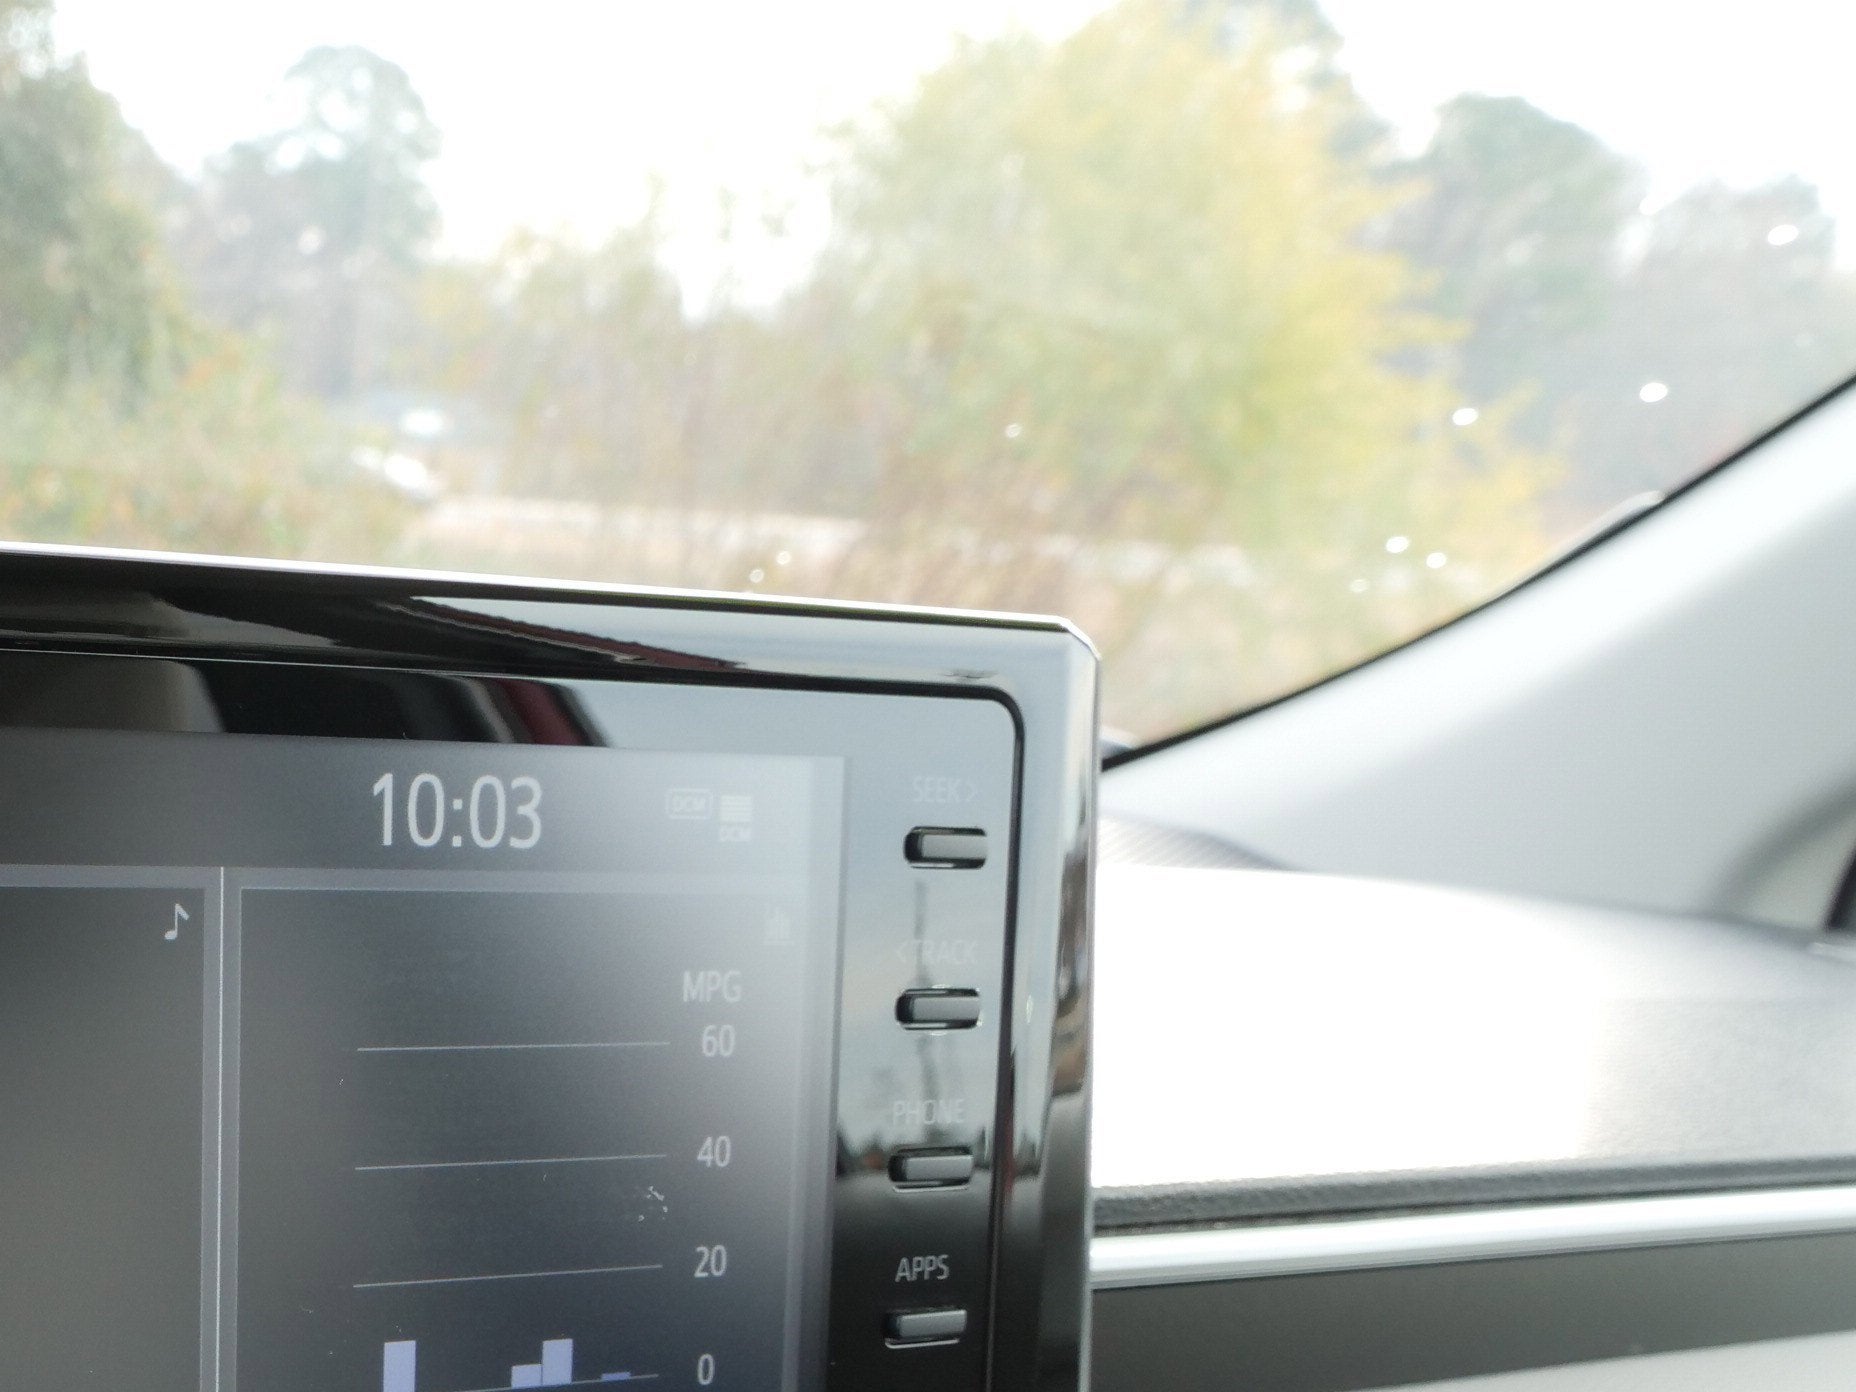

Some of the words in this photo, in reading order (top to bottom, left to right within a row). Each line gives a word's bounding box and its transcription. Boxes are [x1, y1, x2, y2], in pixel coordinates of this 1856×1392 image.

[371, 771, 544, 850] 10:03
[681, 968, 742, 1004] MPG
[700, 1024, 736, 1059] 60
[892, 1098, 965, 1126] PHONE
[696, 1135, 732, 1169] 40
[693, 1244, 728, 1279] 20
[894, 1253, 950, 1284] APPS
[696, 1353, 716, 1386] 0
